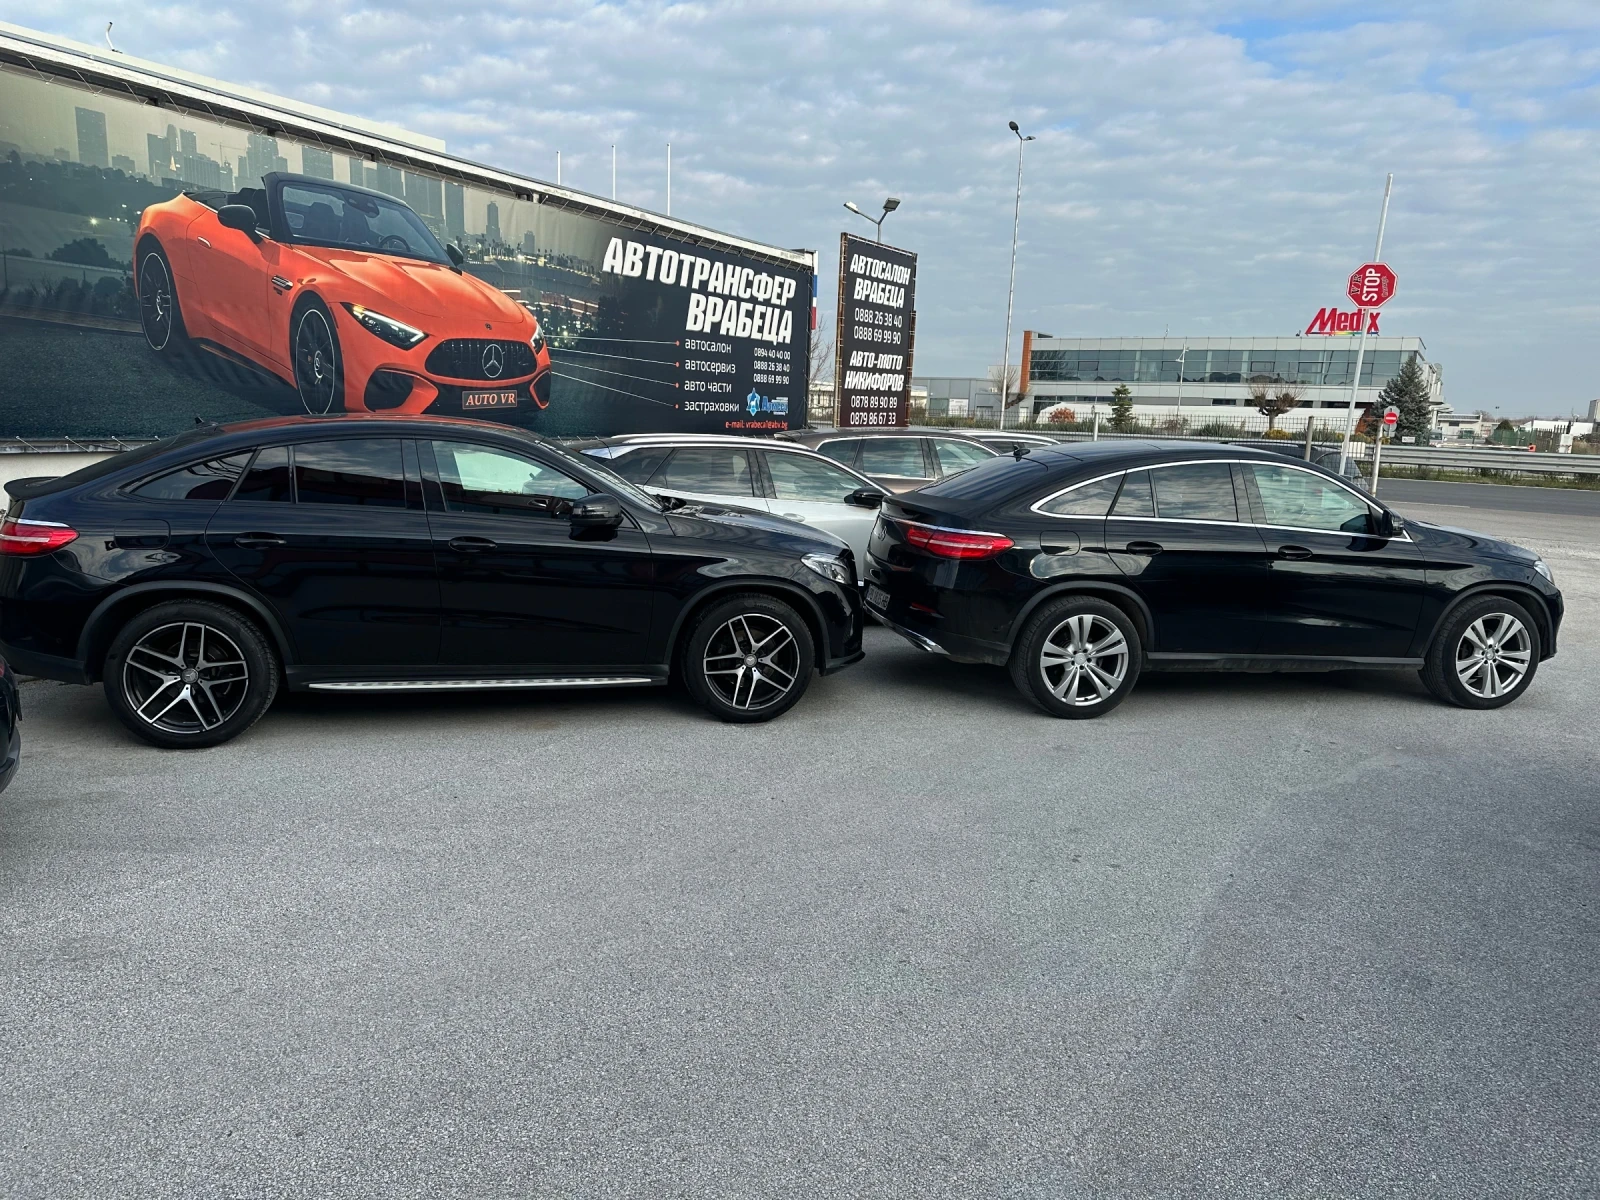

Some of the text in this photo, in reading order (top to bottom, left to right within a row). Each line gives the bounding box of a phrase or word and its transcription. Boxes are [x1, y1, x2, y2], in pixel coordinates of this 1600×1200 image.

[602, 236, 797, 307] АВТОТРАНСФЕР
[850, 253, 911, 286] АВТОСАЛОН
[853, 277, 905, 309] ВРАБЕЦА
[1362, 268, 1381, 302] STOP
[685, 292, 793, 346] ВРАБЕЦА
[854, 308, 902, 328] 0888 26 38 40
[854, 326, 901, 344] 0888 69 99 90
[685, 338, 732, 354] автосалон
[768, 349, 775, 359] 40
[776, 350, 783, 359] 40
[784, 351, 791, 360] 00
[849, 350, 903, 370] АВТО-МОТО
[685, 359, 736, 375] автосервиз
[768, 362, 776, 371] 26
[776, 362, 783, 372] 38
[684, 380, 732, 393] авто части
[783, 376, 790, 385] 90
[844, 370, 904, 392] НИКИФОРОВ
[465, 393, 516, 406] AUTO VR
[684, 401, 740, 414] застраховки
[851, 395, 898, 409] 0878 89 90 89
[850, 412, 897, 425] 0879 86 67 33
